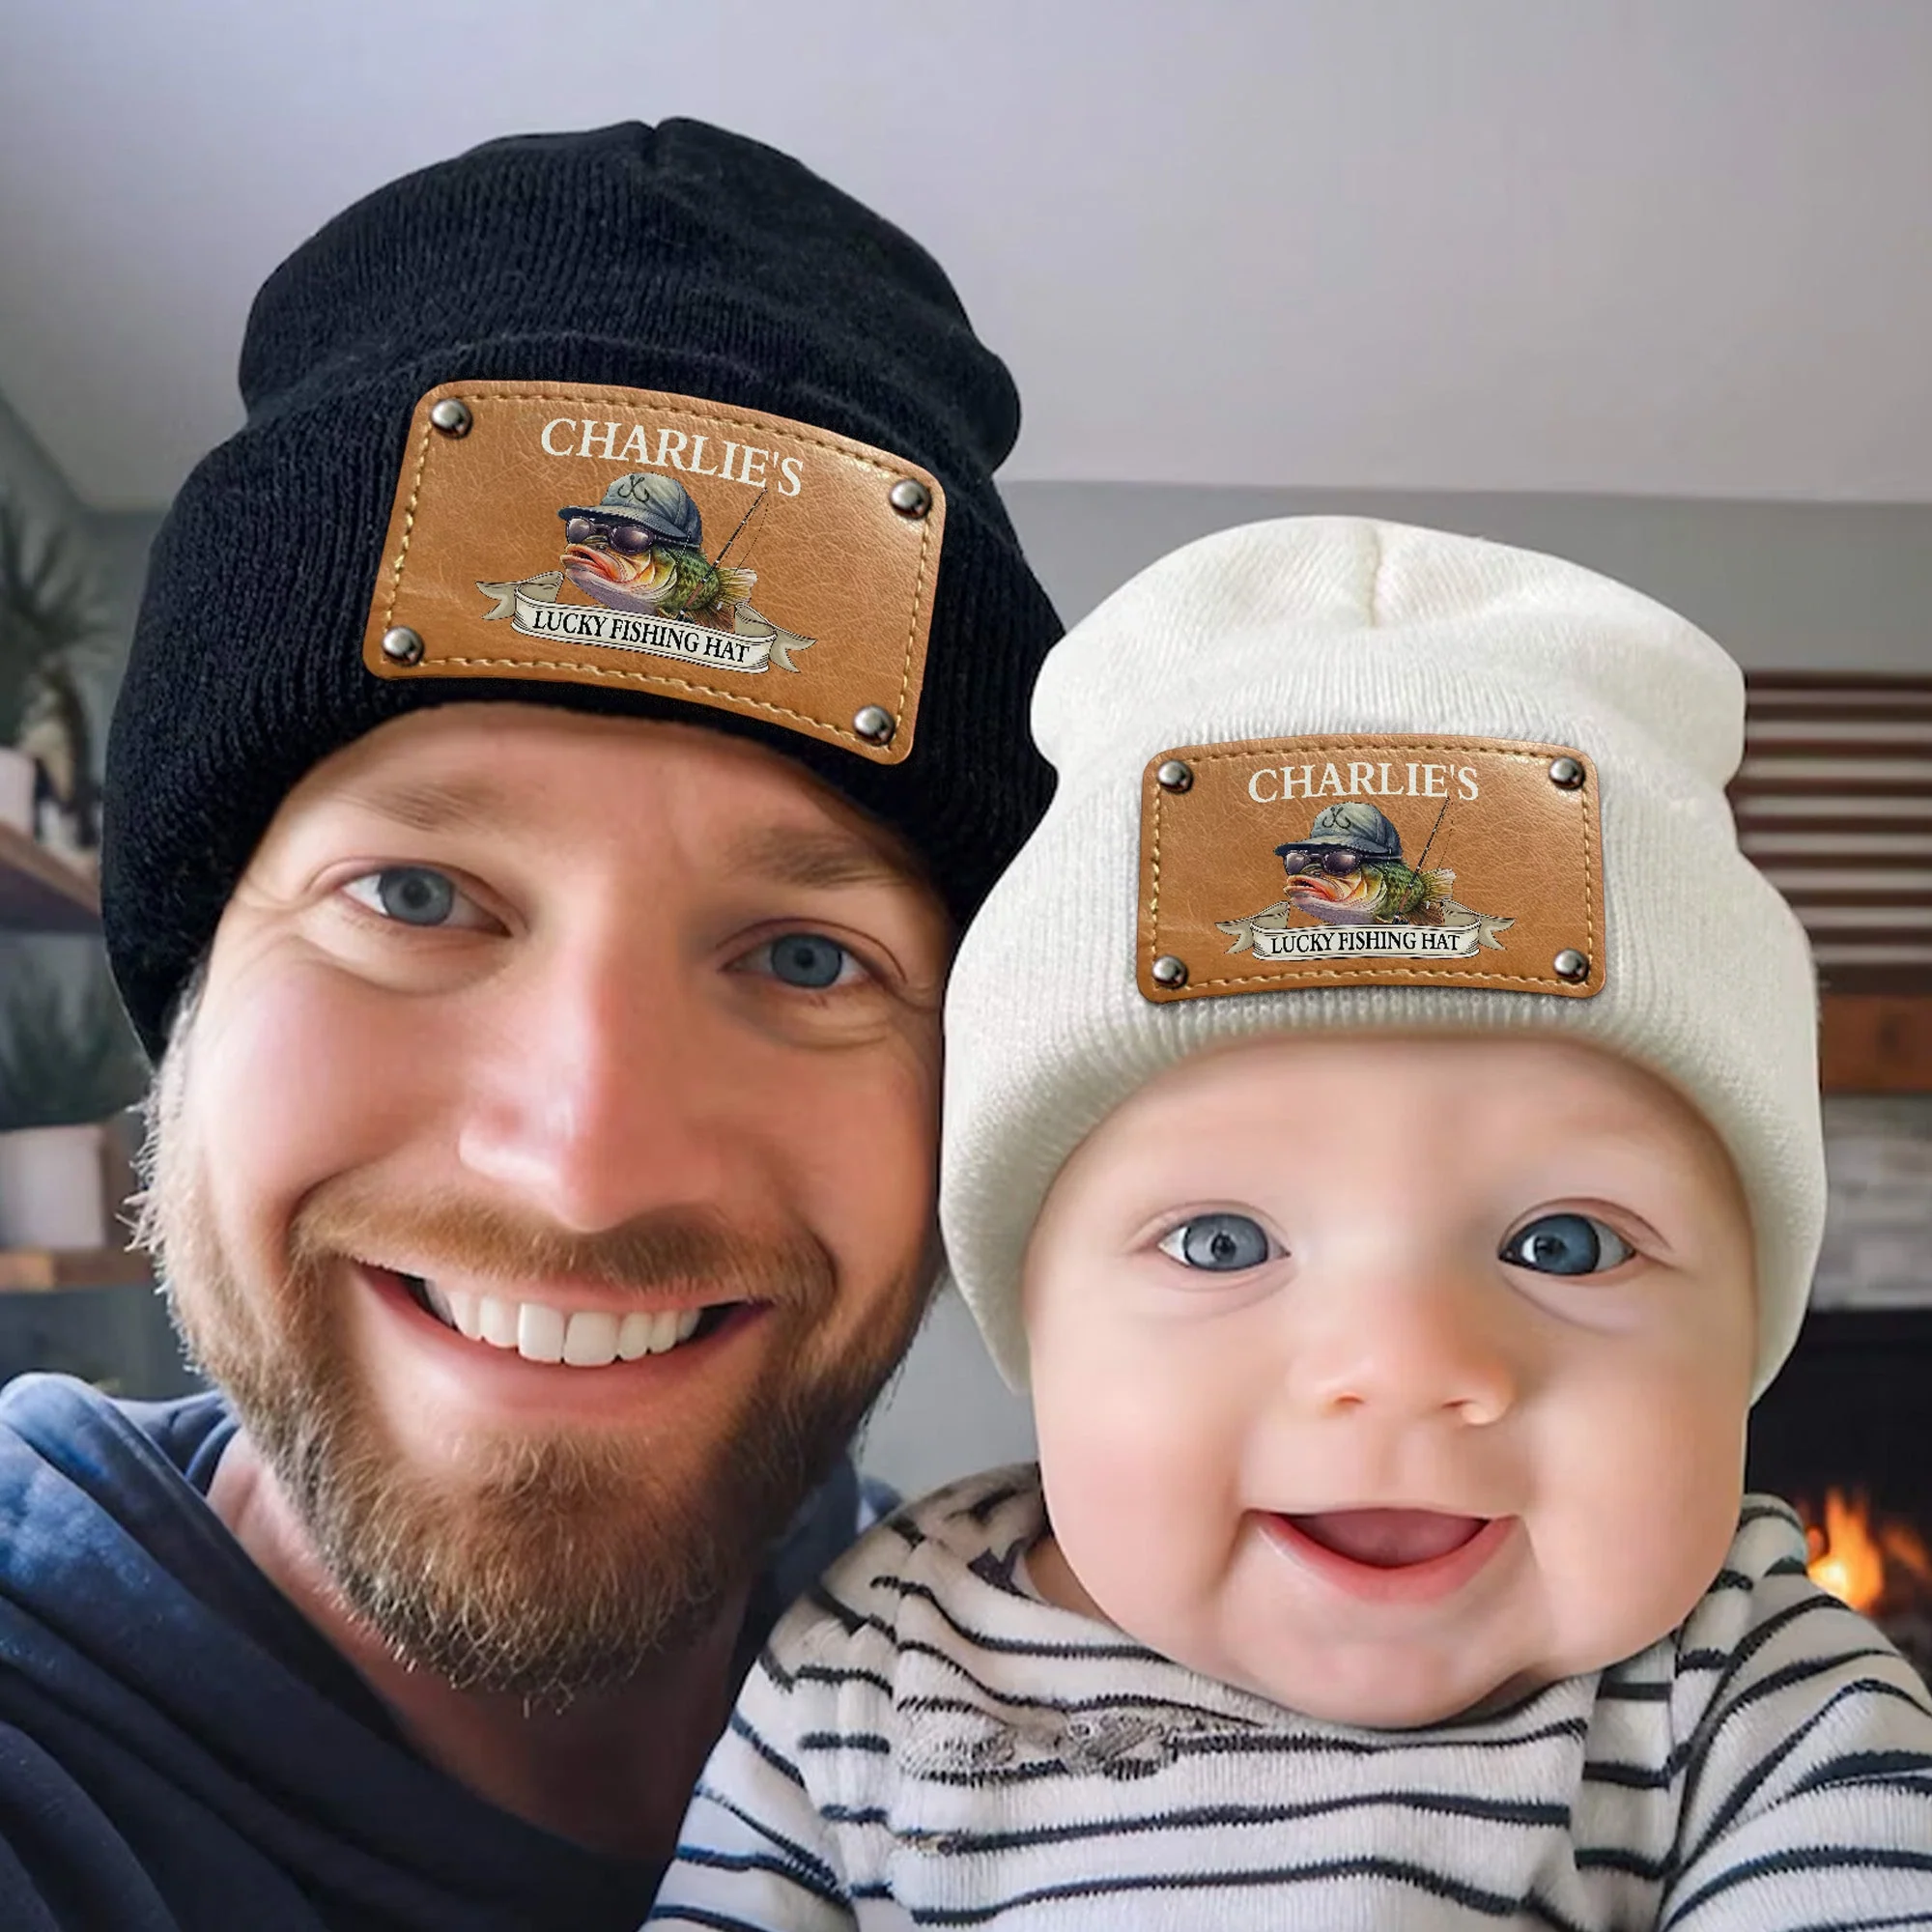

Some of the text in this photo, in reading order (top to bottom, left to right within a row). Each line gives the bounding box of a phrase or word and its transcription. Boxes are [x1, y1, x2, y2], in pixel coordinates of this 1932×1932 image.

[540, 417, 804, 497] CHARLIE'S
[532, 610, 750, 663] LUCKY FISHING HAT
[1248, 761, 1479, 803] CHARLIE'S
[1270, 930, 1461, 954] LUCKY FISHING HAT
